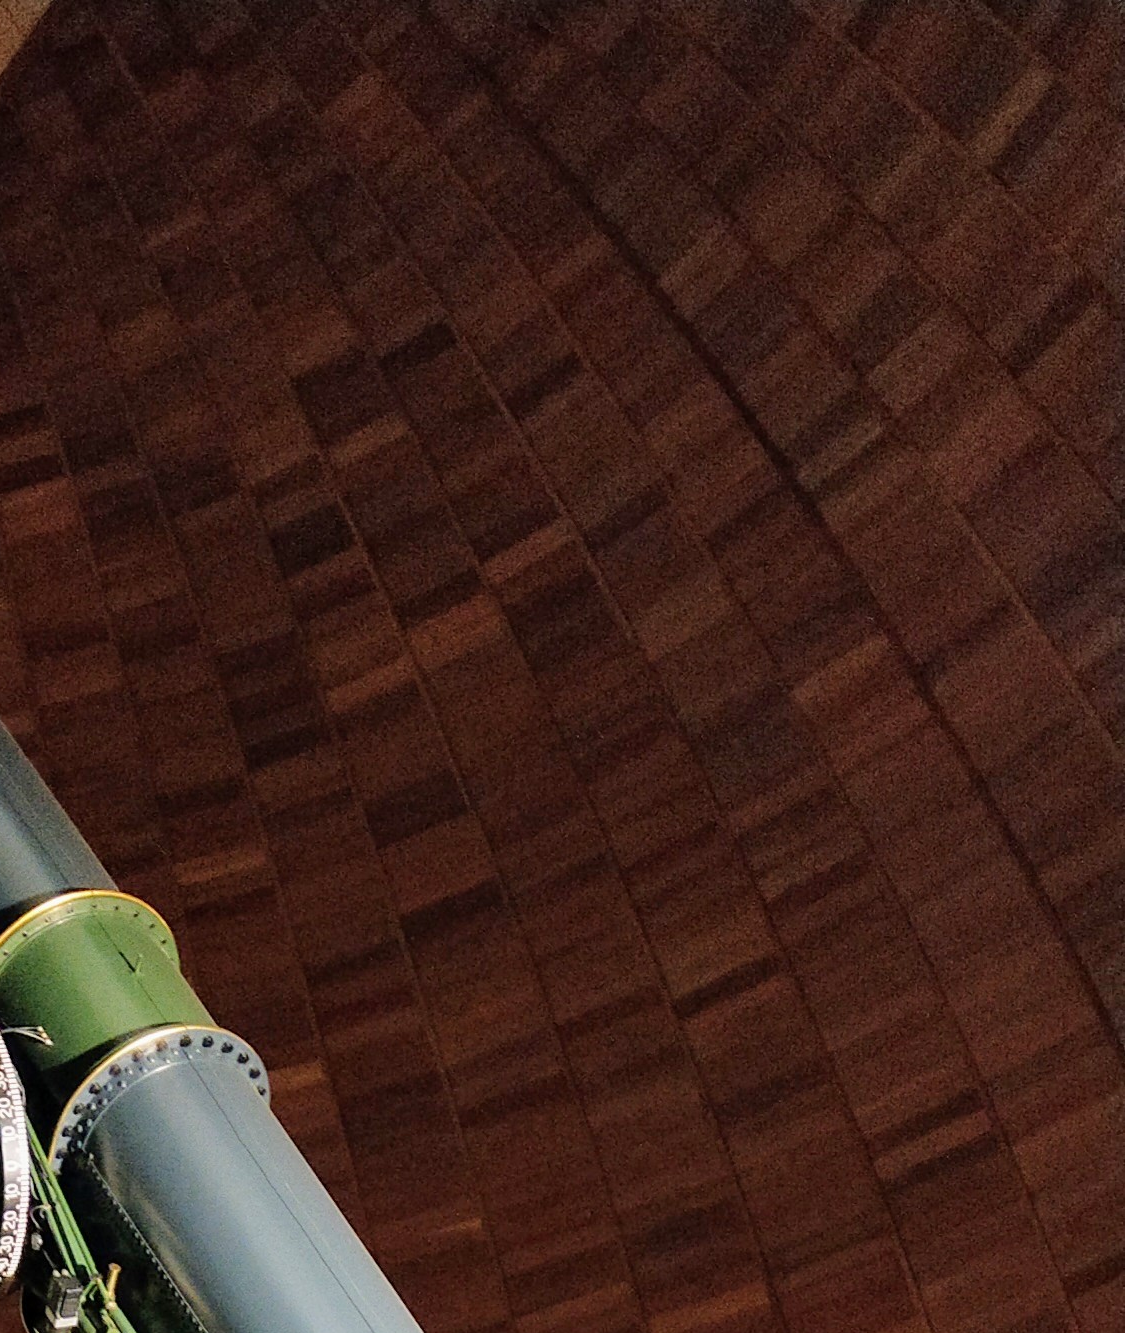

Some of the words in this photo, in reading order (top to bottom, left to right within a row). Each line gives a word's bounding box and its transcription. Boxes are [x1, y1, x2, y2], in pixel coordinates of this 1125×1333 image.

[1, 1125, 16, 1141] 10
[5, 1160, 18, 1172] 0
[4, 1183, 19, 1200] 10
[2, 1210, 17, 1230] 20
